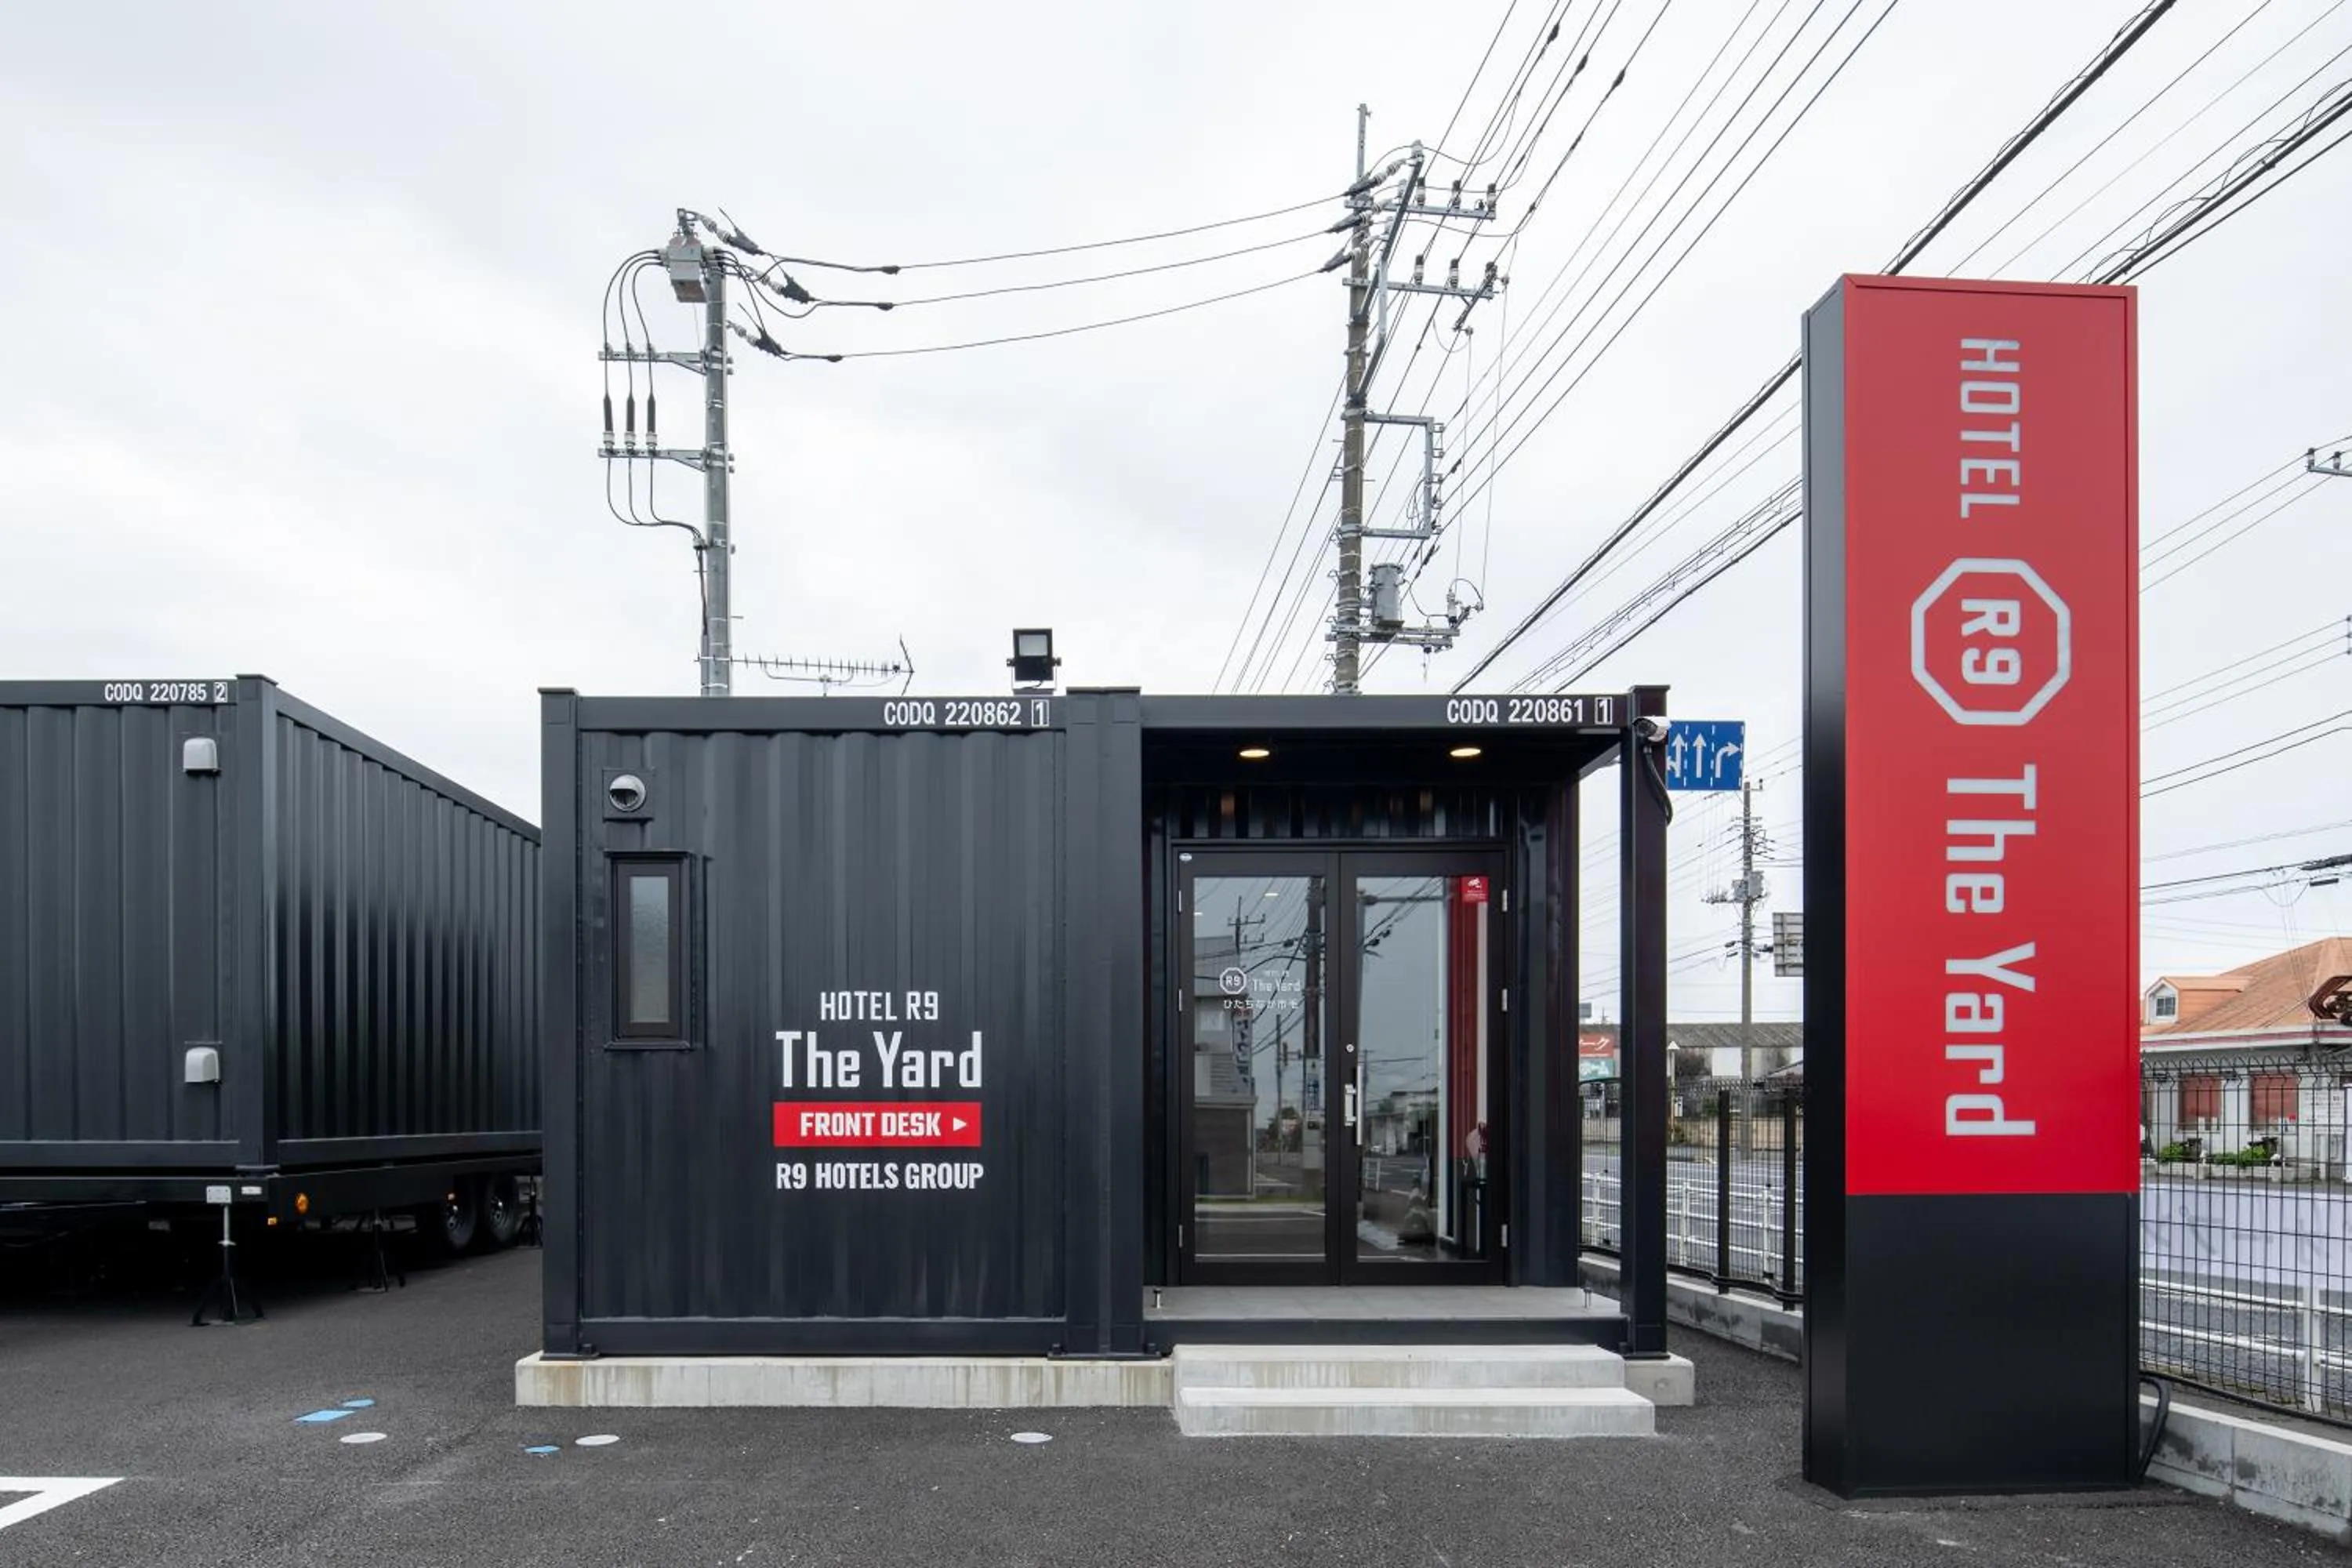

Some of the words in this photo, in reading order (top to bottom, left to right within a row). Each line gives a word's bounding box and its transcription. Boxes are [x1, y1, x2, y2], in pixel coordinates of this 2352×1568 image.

[1960, 338, 2020, 518] HOTEL
[1961, 598, 2021, 685] R9
[104, 683, 143, 702] CODQ
[150, 683, 207, 702] 220785
[215, 683, 227, 702] 2
[884, 701, 936, 726] CODQ
[944, 701, 1022, 726] 220862
[1033, 700, 1045, 726] 1
[1446, 699, 1499, 724] CODQ
[1508, 699, 1583, 723] 220861
[1597, 699, 1609, 724] 1
[1946, 764, 2037, 913] The
[1225, 975, 1240, 986] R9
[1253, 978, 1272, 992] The
[1276, 978, 1301, 992] Yard
[820, 991, 898, 1021] HOTEL
[906, 991, 939, 1021] R9
[1579, 1036, 1610, 1051] ーク
[1945, 942, 2035, 1135] Yard
[775, 1030, 861, 1088] The
[873, 1030, 982, 1088] Yard
[800, 1112, 876, 1137] FRONT
[880, 1112, 942, 1137] DESK
[776, 1163, 807, 1189] R9
[815, 1162, 899, 1189] HOTELS
[905, 1162, 984, 1189] GROUP
